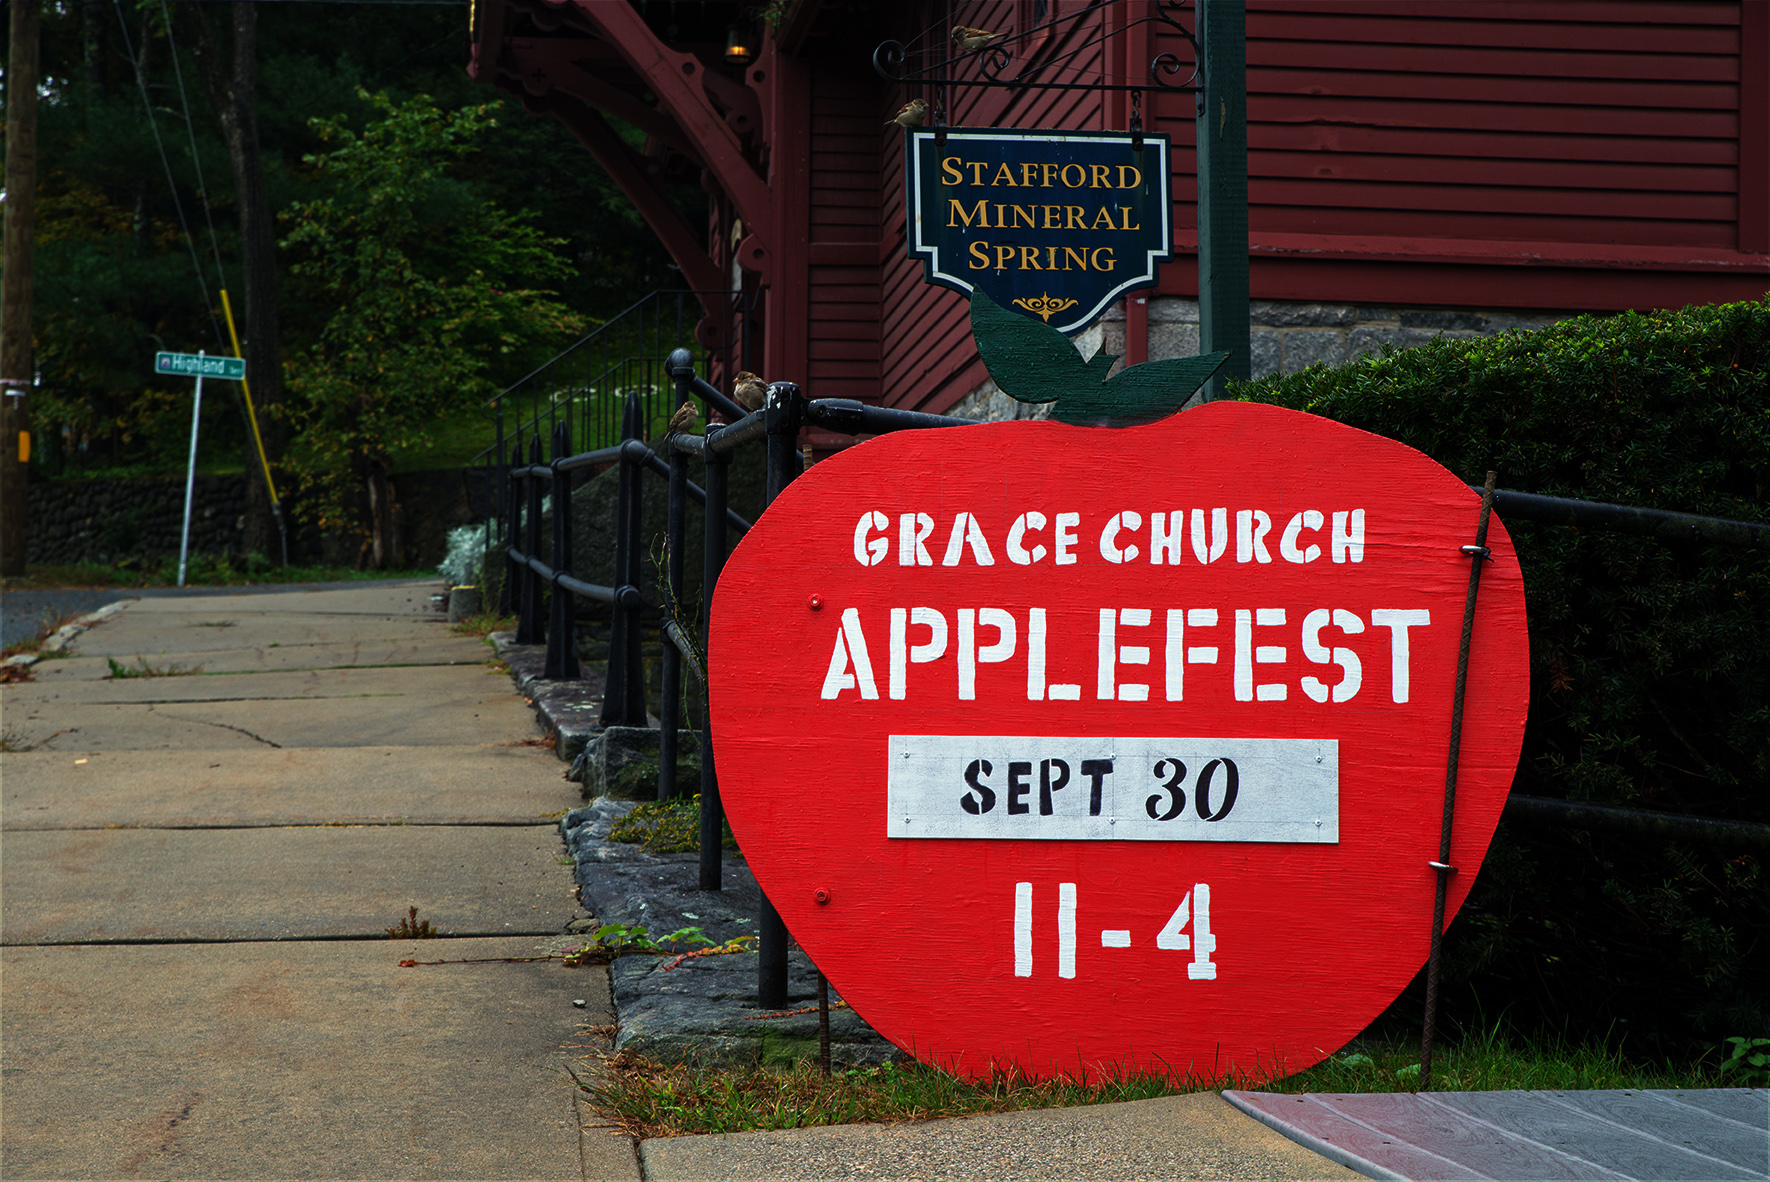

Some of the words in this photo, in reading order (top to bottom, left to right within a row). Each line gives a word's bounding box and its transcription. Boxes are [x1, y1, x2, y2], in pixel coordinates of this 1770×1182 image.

[941, 157, 1142, 189] STAFFORD
[946, 199, 1140, 230] MINERAL
[969, 241, 1118, 271] SPRING
[172, 355, 225, 375] Highland
[853, 511, 1081, 567] GRACE
[1099, 508, 1366, 566] CHURCH
[820, 607, 1431, 703] APPLEFEST
[960, 758, 1114, 817] SEPT
[1145, 758, 1240, 822] 30
